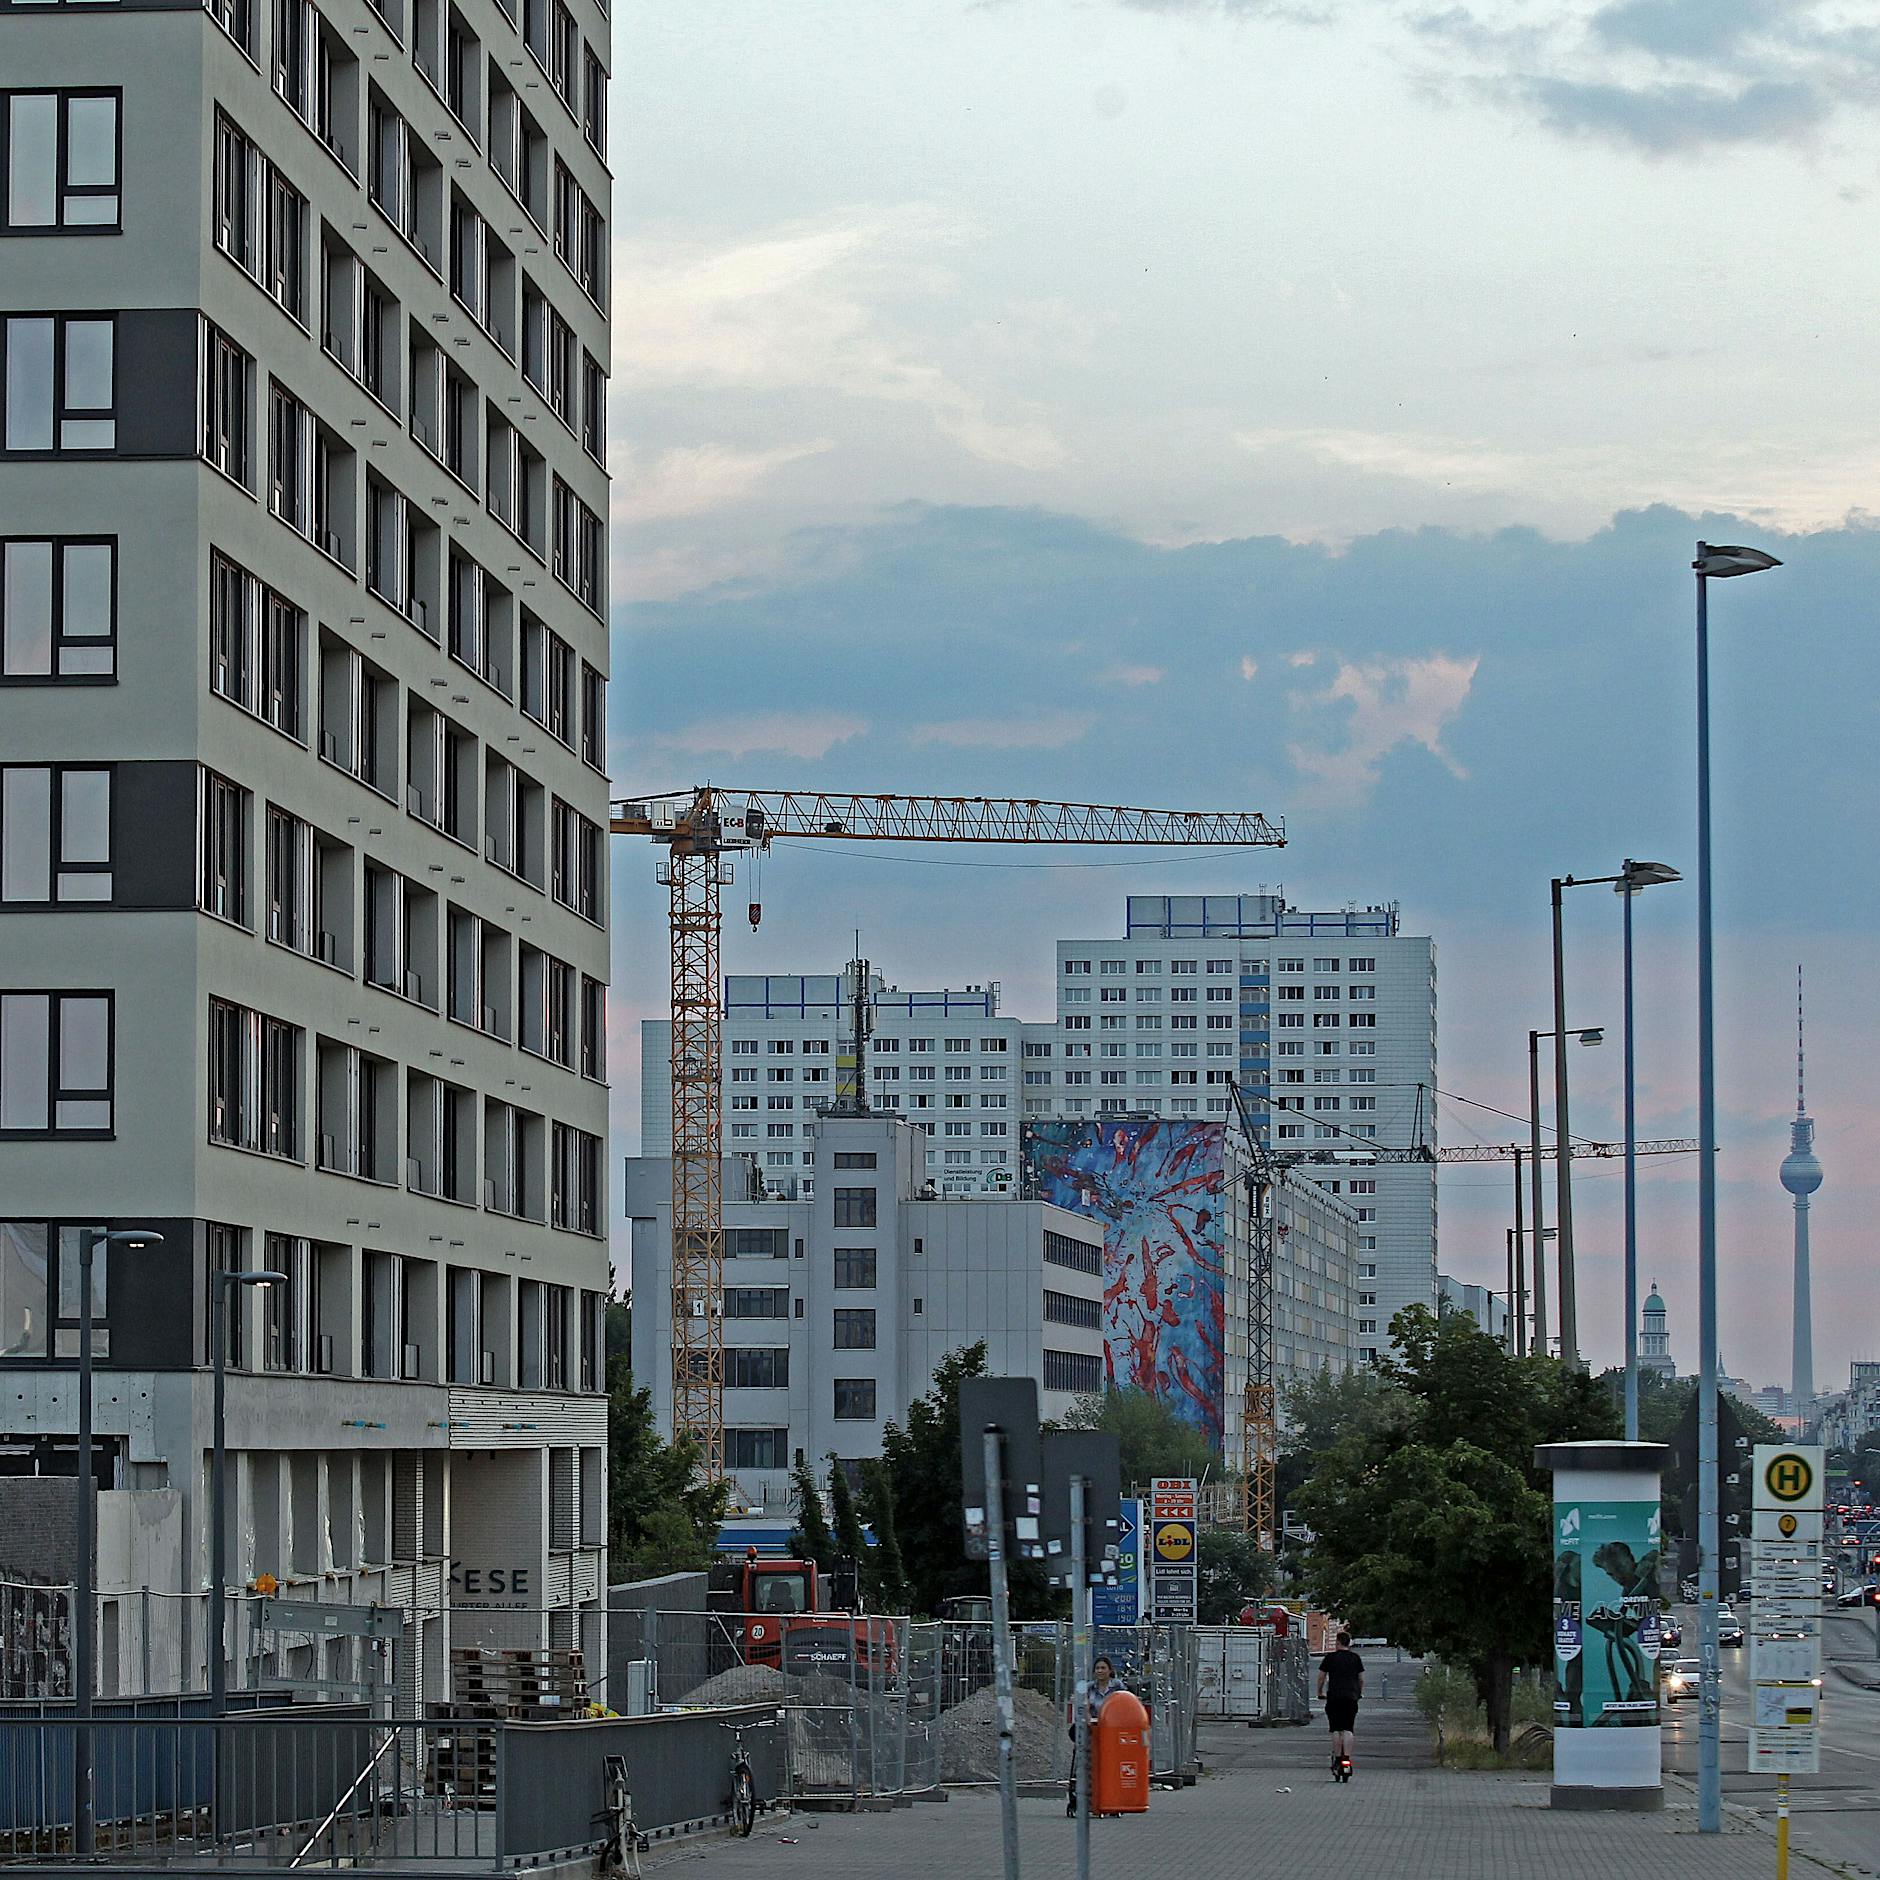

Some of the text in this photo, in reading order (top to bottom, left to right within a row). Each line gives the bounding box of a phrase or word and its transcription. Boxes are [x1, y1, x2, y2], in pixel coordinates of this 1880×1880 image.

[1778, 1465, 1800, 1490] H
[1157, 1480, 1191, 1490] OBI
[1561, 1618, 1569, 1630] 3
[1649, 1616, 1656, 1628] 3
[810, 1653, 847, 1661] SCHAEFF
